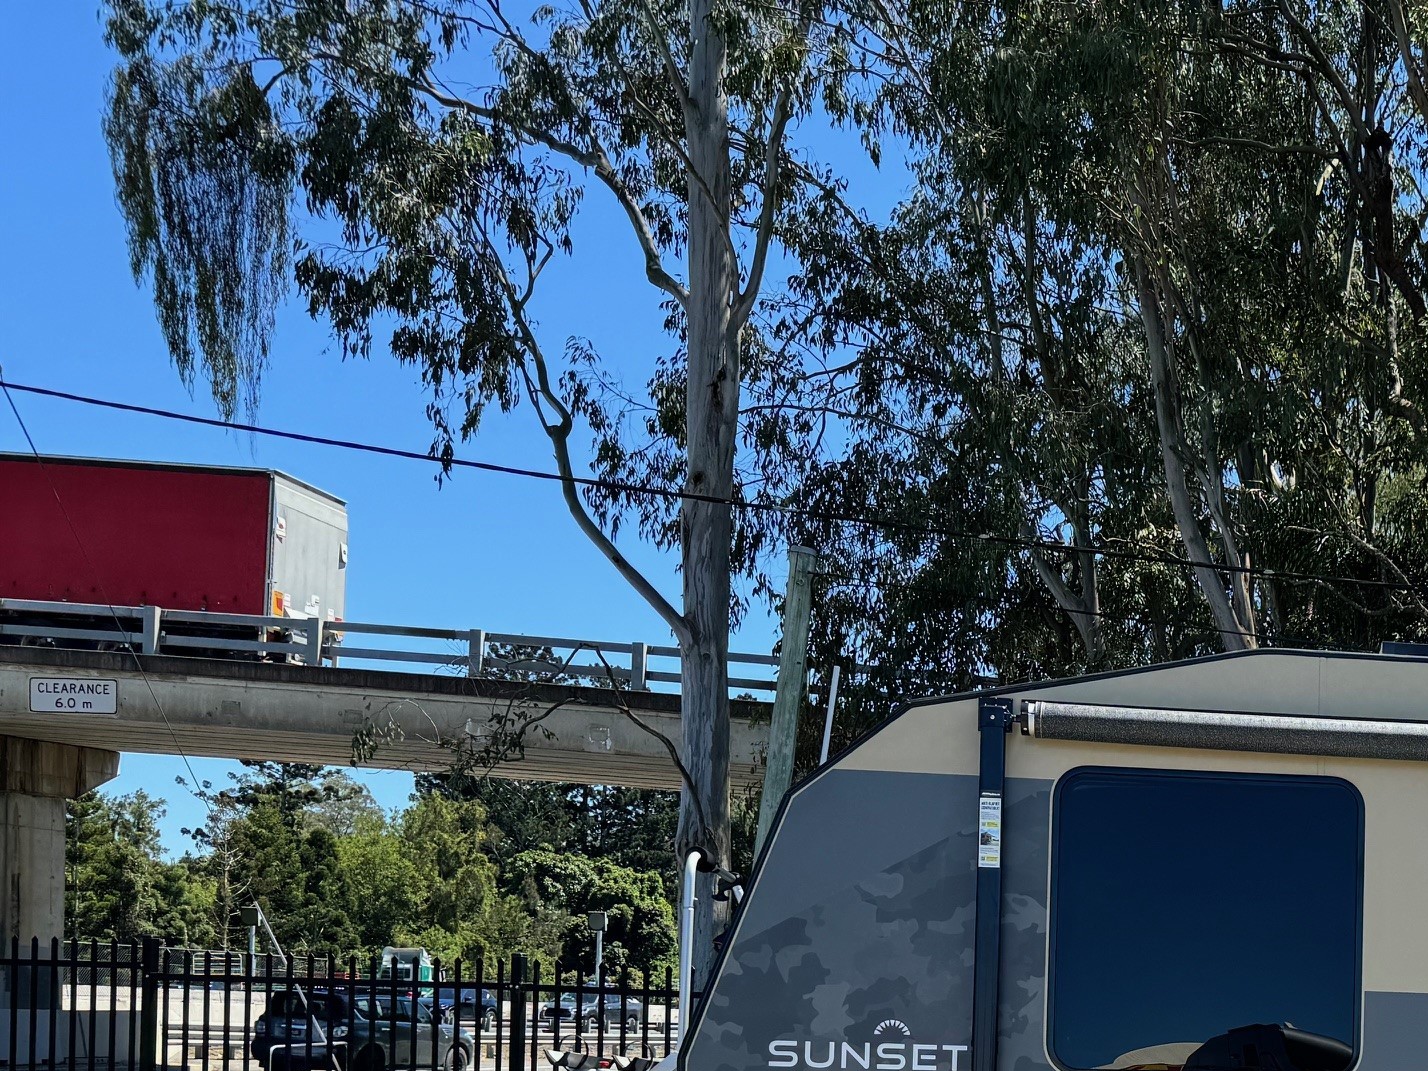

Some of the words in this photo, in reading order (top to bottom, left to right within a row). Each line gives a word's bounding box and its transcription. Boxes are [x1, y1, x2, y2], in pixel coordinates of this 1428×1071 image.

[37, 682, 110, 695] CLEARANCE
[55, 697, 76, 708] 6.0
[82, 701, 92, 709] m
[768, 1040, 968, 1071] SUNSET
